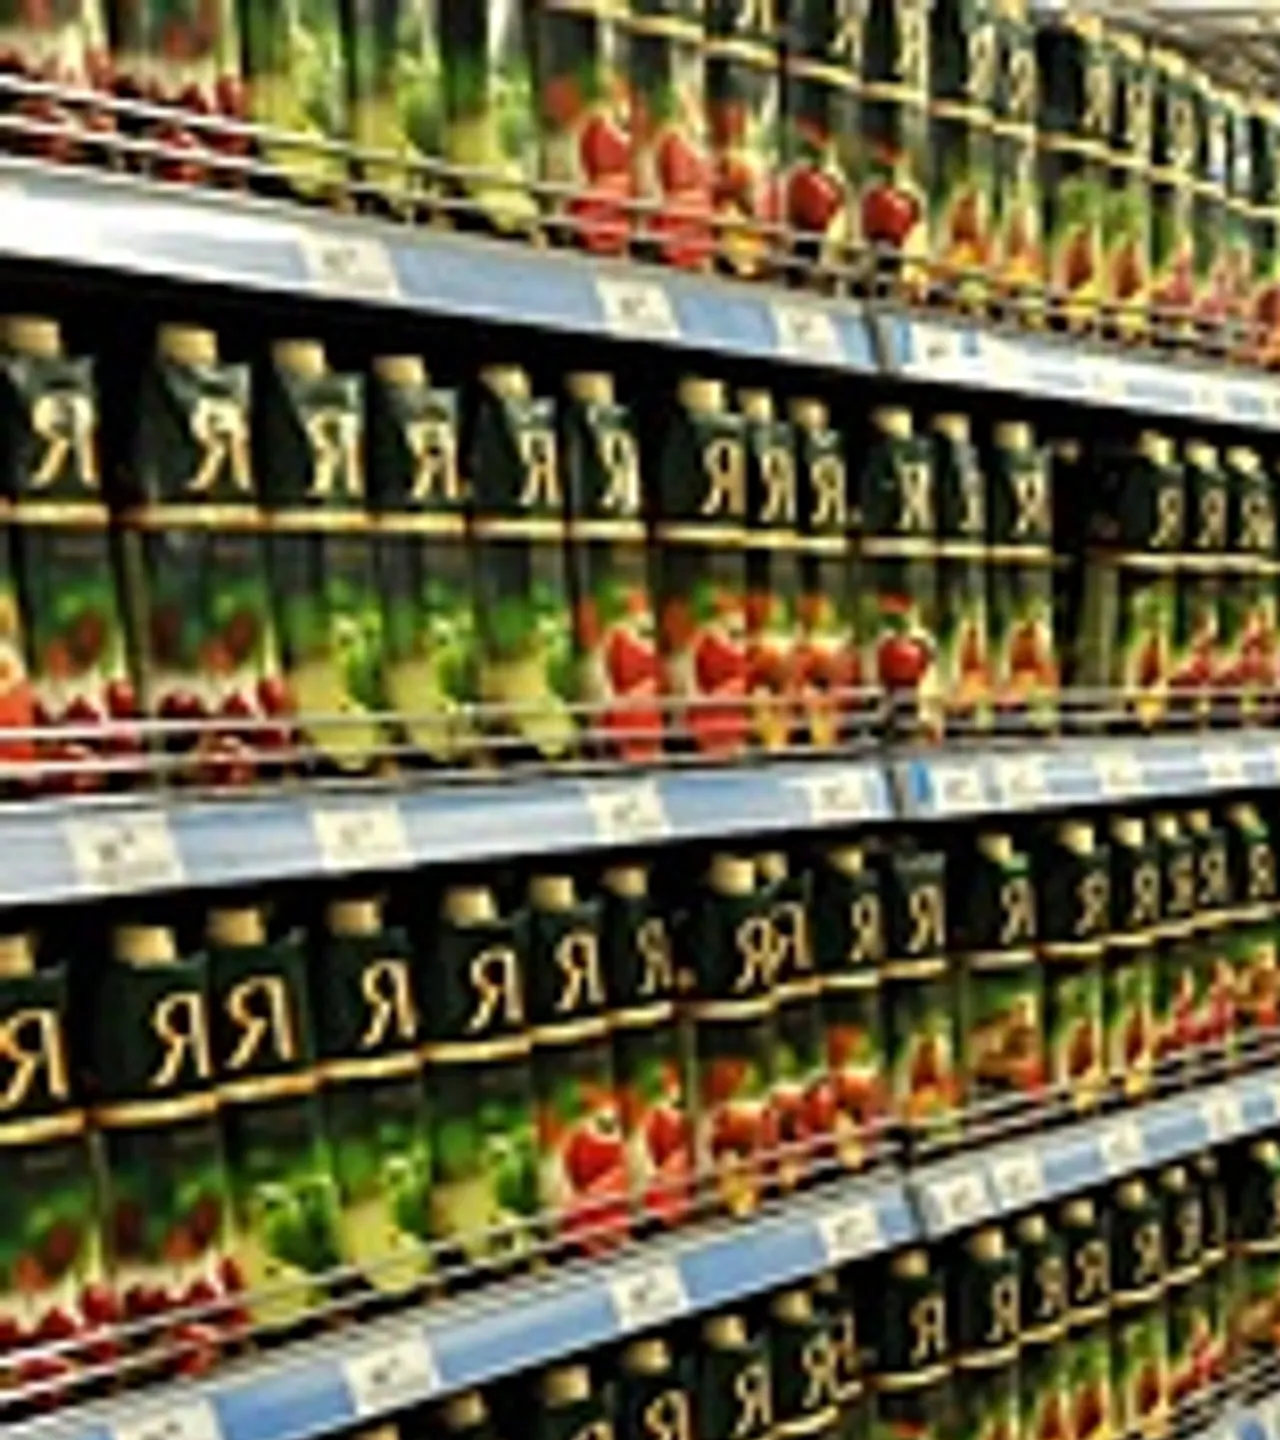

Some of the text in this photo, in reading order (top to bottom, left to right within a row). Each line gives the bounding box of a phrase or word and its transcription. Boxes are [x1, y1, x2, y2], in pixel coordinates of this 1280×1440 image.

[31, 397, 98, 489] Я
[188, 397, 254, 491] Я
[306, 409, 364, 497] Я
[407, 420, 458, 499] Я
[518, 428, 561, 506] Я
[601, 430, 640, 512] Я
[704, 438, 746, 514] Я
[760, 448, 796, 521] Я
[809, 456, 846, 524] Я
[901, 464, 933, 530] Я
[1015, 470, 1051, 534] Я
[1149, 487, 1184, 547] Я
[1196, 488, 1227, 547] Я
[1241, 489, 1276, 549] Я
[851, 893, 882, 962] Я
[908, 884, 945, 953] Я
[1002, 878, 1035, 944] Я
[1075, 872, 1110, 936] Я
[1131, 864, 1159, 922] Я
[466, 948, 523, 1034] Я
[555, 932, 602, 1012] Я
[637, 917, 674, 993] Я
[733, 916, 774, 993] Я
[151, 992, 211, 1088] Я
[225, 976, 295, 1069] Я
[360, 959, 416, 1049] Я
[0, 1009, 68, 1106] Я
[1037, 1257, 1067, 1317] Я
[1076, 1240, 1109, 1299] Я
[1133, 1222, 1161, 1283] Я
[910, 1295, 946, 1364] Я
[987, 1275, 1019, 1342] Я
[734, 1362, 773, 1437] Я
[802, 1333, 840, 1407] Я
